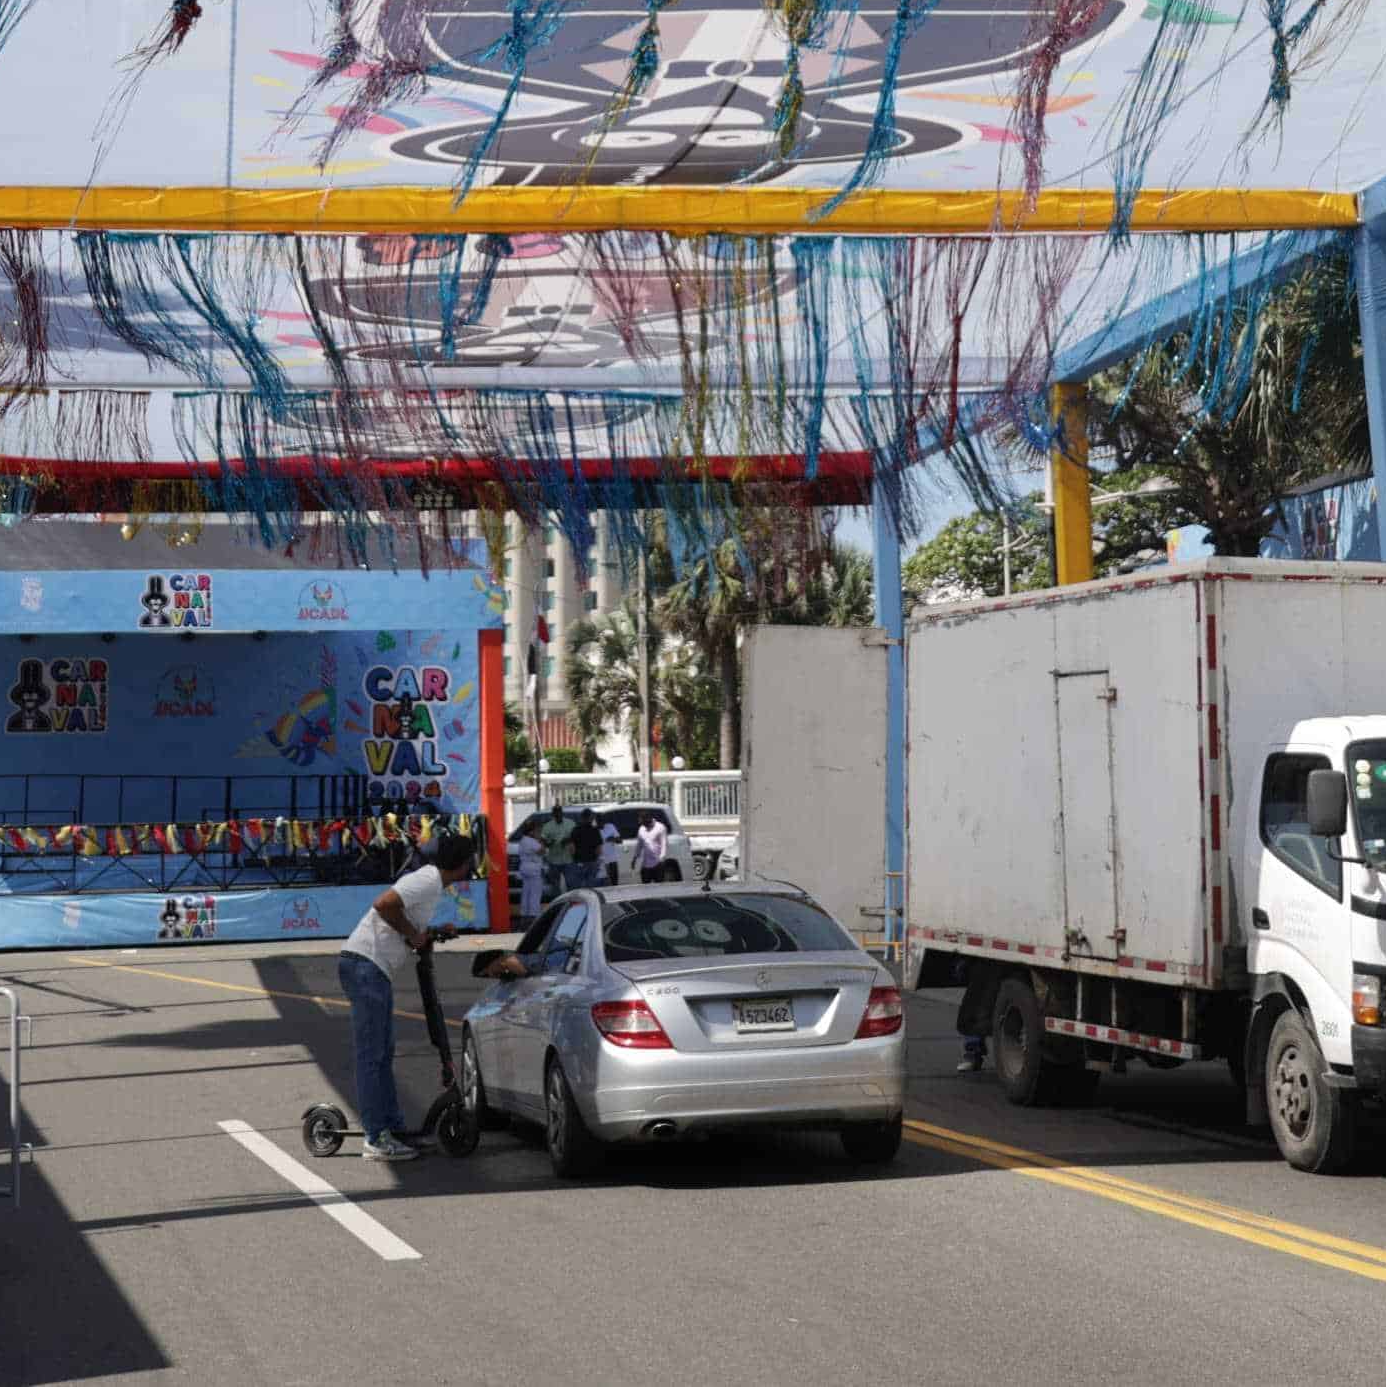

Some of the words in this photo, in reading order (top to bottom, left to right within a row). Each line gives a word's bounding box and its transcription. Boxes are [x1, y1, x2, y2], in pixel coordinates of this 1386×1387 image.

[169, 574, 211, 591] CAR
[50, 660, 108, 683] CAR
[365, 666, 449, 701] CAR
[364, 740, 447, 776] VAL
